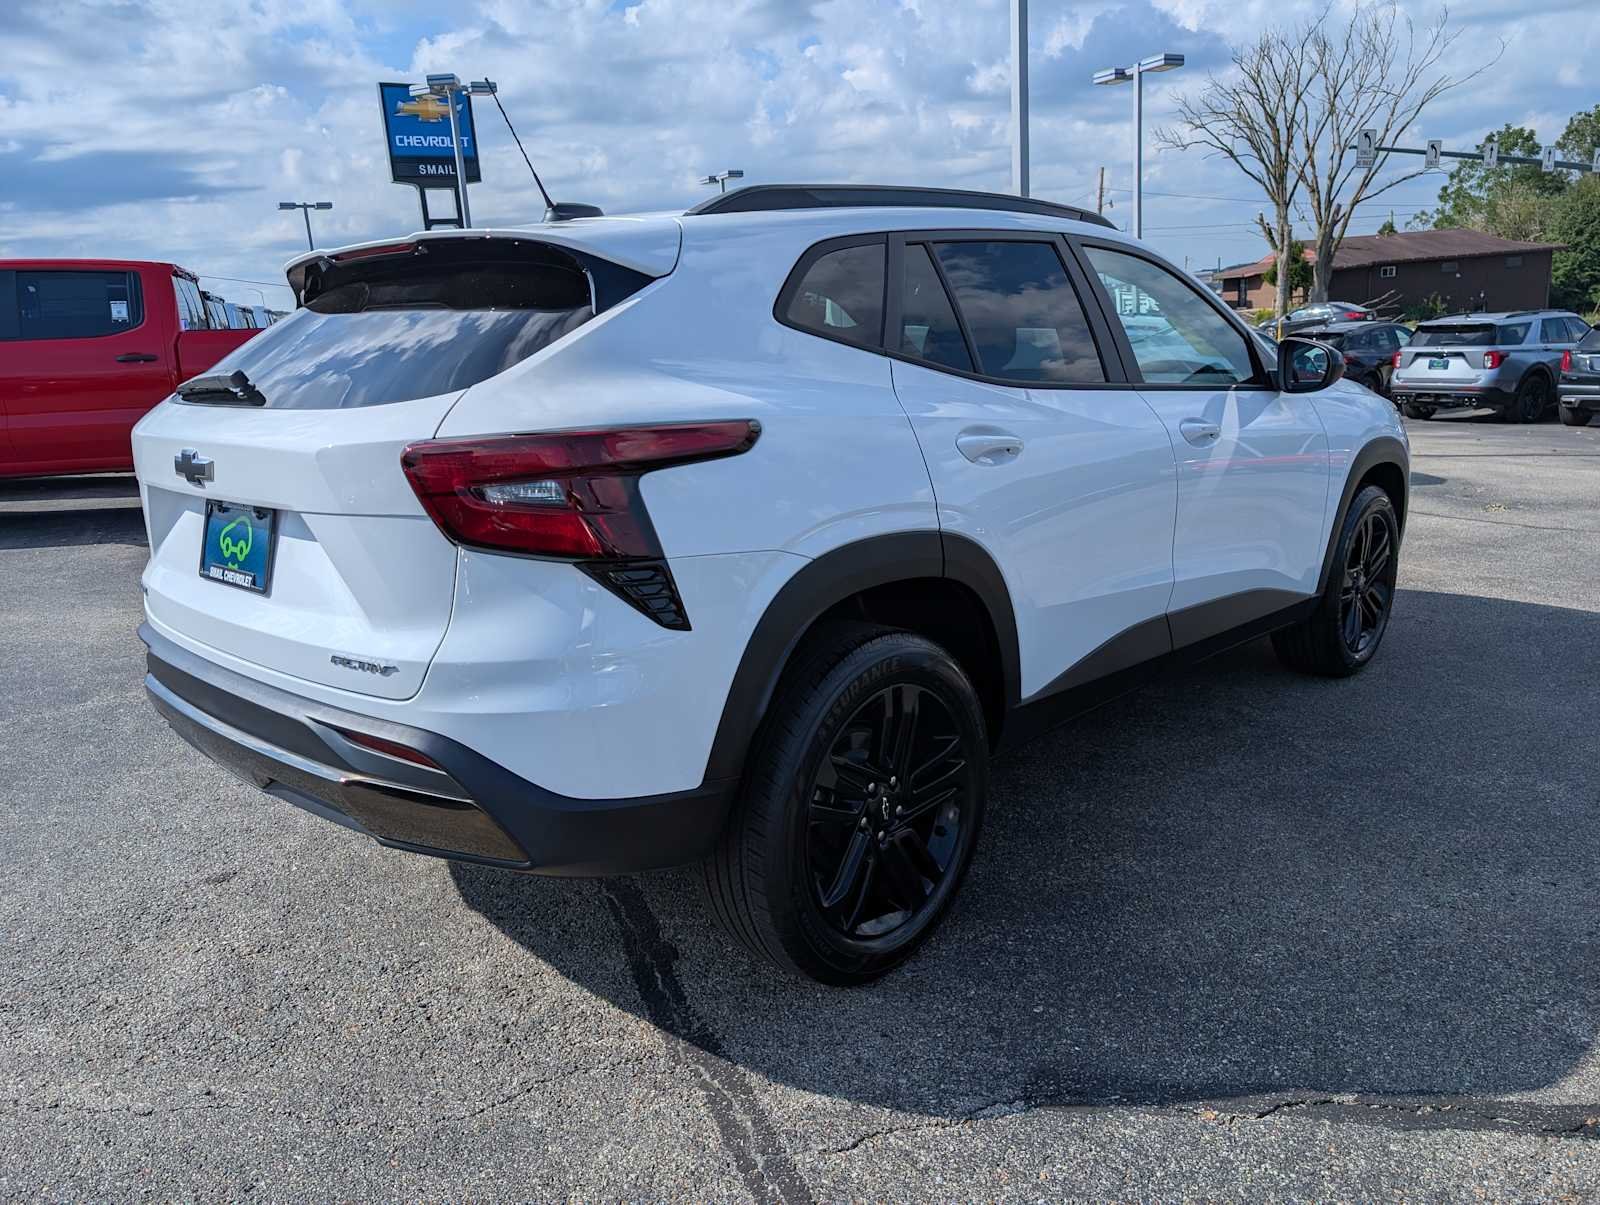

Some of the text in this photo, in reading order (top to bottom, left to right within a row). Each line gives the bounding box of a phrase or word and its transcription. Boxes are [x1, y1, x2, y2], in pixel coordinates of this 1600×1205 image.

[395, 135, 469, 147] CHEVROLT
[419, 164, 456, 175] SMAIL
[224, 570, 252, 588] CHEVROLET
